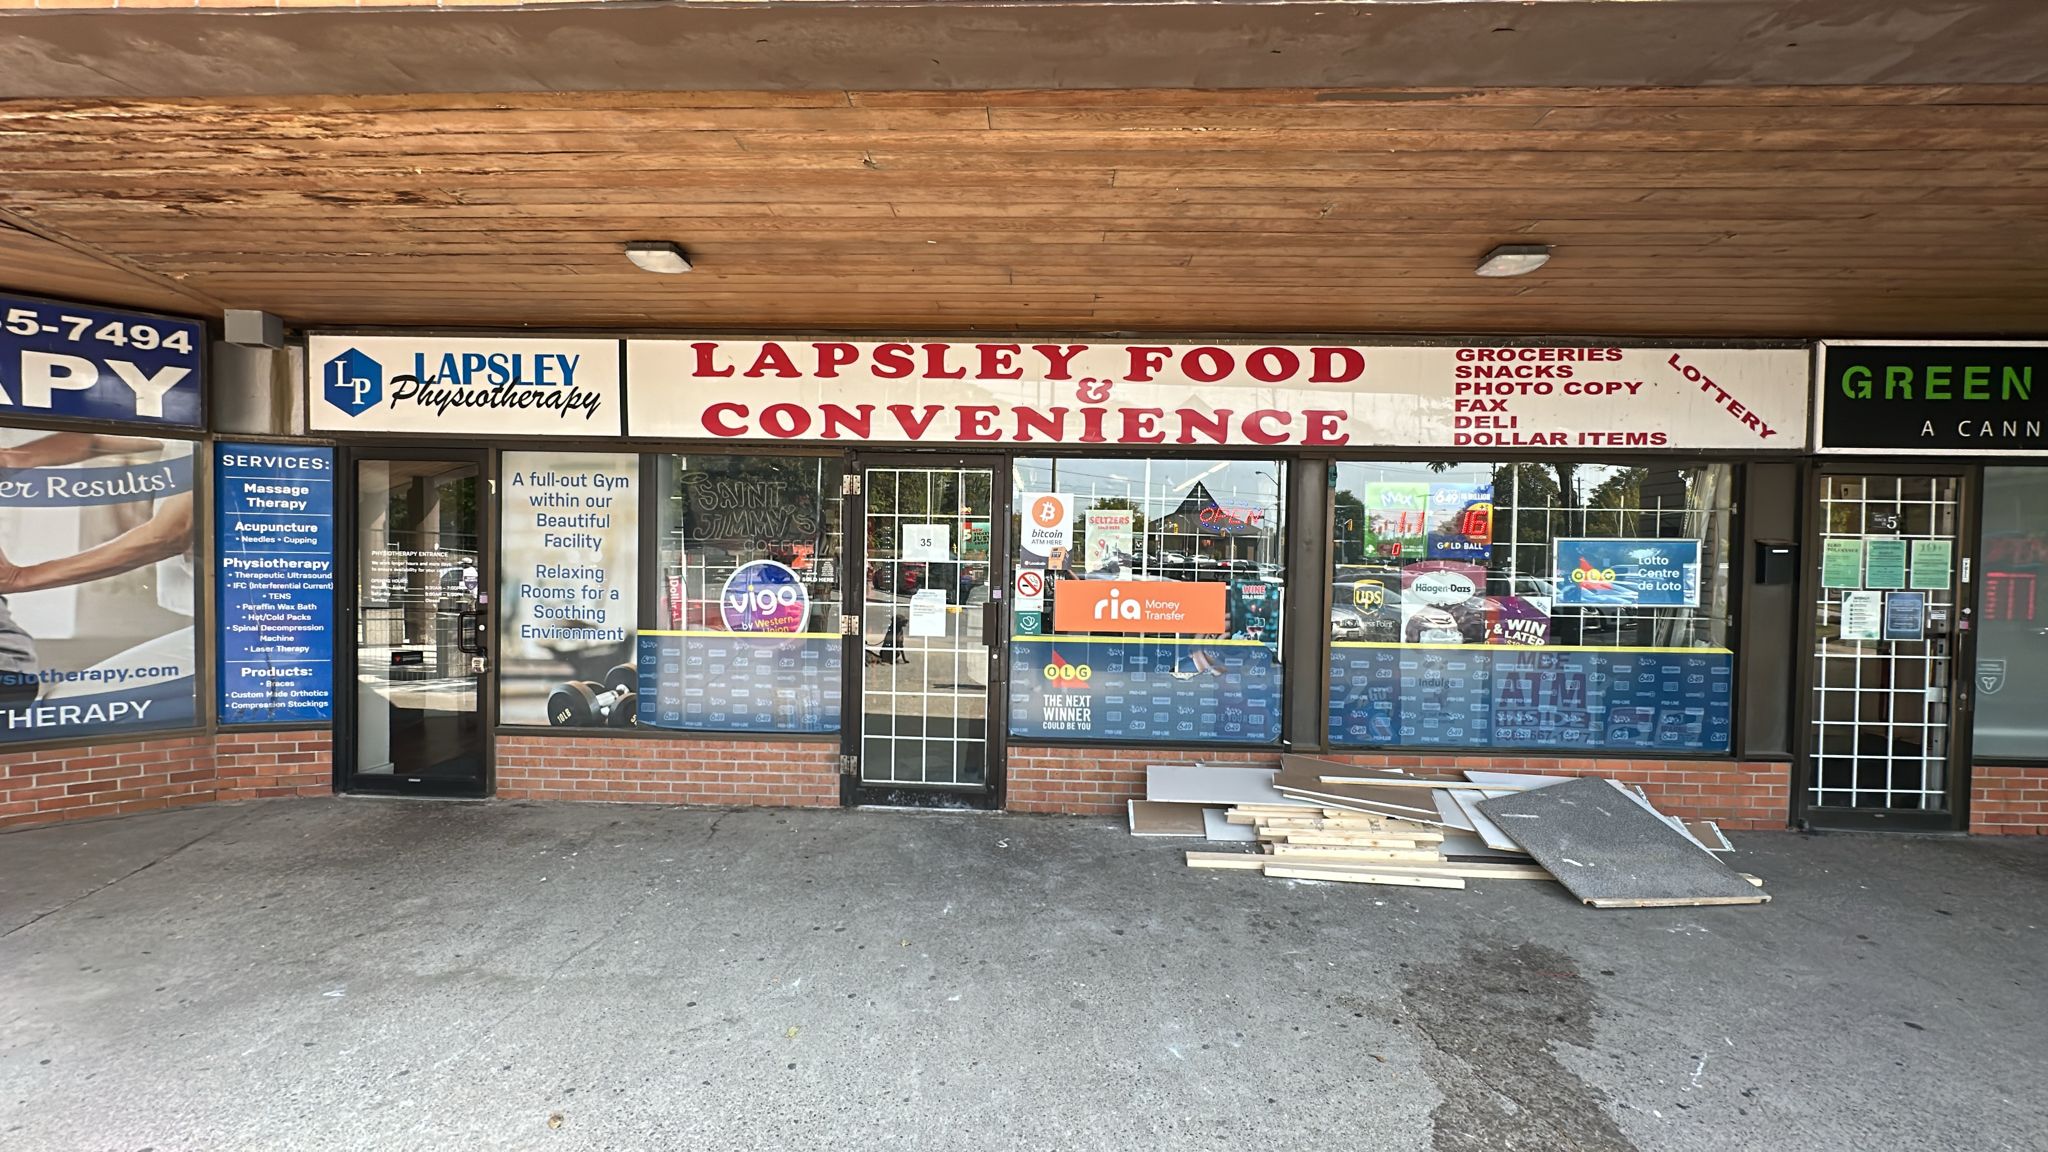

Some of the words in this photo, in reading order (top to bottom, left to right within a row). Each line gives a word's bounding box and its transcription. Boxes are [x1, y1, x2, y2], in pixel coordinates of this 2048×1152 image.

[0, 308, 193, 355] 5-7494
[690, 342, 1090, 381] LAPSLEY
[1123, 346, 1366, 384] FOOD
[1456, 349, 1624, 362] GROCERIES
[415, 353, 580, 386] LAPSLEY
[1455, 365, 1574, 379] SNACKS
[0, 350, 193, 418] PY
[1076, 377, 1113, 403] &
[1455, 382, 1555, 396] PHOTO
[1563, 382, 1644, 396] COPY
[1841, 365, 2033, 400] GREEN
[389, 374, 602, 420] Physiotherapy
[1667, 353, 1778, 440] LOTTERY
[1455, 399, 1510, 413] FAX
[701, 402, 1350, 446] CONVENIENCE
[1454, 416, 1518, 429] DELI
[1921, 420, 1935, 437] A
[1454, 432, 1569, 446] DOLLAR
[1578, 433, 1667, 446] ITEMS
[223, 454, 330, 470] SERVICES:
[47, 466, 176, 499] Results!
[512, 472, 524, 487] A
[530, 472, 587, 488] full-out
[593, 473, 629, 491] Gym
[244, 483, 309, 496] Massage
[695, 481, 787, 511] SAINT
[246, 497, 307, 511] Therapy
[529, 493, 579, 508] within
[585, 496, 613, 508] our
[536, 513, 610, 528] Beautiful
[692, 505, 818, 541] JIMMY'S
[1089, 516, 1130, 525] SELTZERS
[1200, 507, 1263, 525] OPEN
[1461, 511, 1488, 535] 16
[1886, 516, 1897, 529] 5
[235, 522, 318, 533] Acupuncture
[1032, 529, 1063, 539] bitcoin
[283, 536, 318, 545] Cupping
[544, 534, 602, 551] Facility
[920, 538, 932, 547] 35
[223, 558, 330, 570] Physiotherapy
[1639, 556, 1669, 566] Lotto
[235, 572, 284, 580] Therapeutic
[536, 565, 604, 582] Relaxing
[1638, 569, 1680, 578] Centre
[521, 584, 576, 599] Rooms
[581, 584, 604, 600] for
[610, 588, 620, 600] a
[1242, 585, 1266, 594] WINE
[1415, 583, 1471, 599] Häagen-Dazs
[1638, 582, 1653, 590] de
[1656, 582, 1681, 591] Loto
[242, 603, 275, 611] Paraffin
[730, 585, 797, 615] vigo
[1094, 588, 1141, 619] ria
[1145, 600, 1179, 613] Money
[1355, 591, 1382, 609] ups
[534, 605, 606, 623] Soothing
[1145, 611, 1185, 621] Transfer
[260, 624, 324, 632] Decompression
[741, 621, 753, 631] by
[754, 616, 793, 628] Western
[1493, 623, 1503, 634] &
[1507, 619, 1547, 638] WIN
[521, 625, 624, 641] Environment
[0, 665, 179, 686] siotherapy.com
[241, 668, 312, 677] Products:
[1045, 665, 1091, 680] OLG
[1419, 677, 1456, 688] Indulge
[288, 700, 328, 708] Stockings
[1043, 694, 1062, 706] THE
[1066, 695, 1091, 707] NEXT
[1043, 707, 1091, 721] WINNER
[1043, 722, 1065, 730] COULD
[1067, 722, 1076, 730] BE
